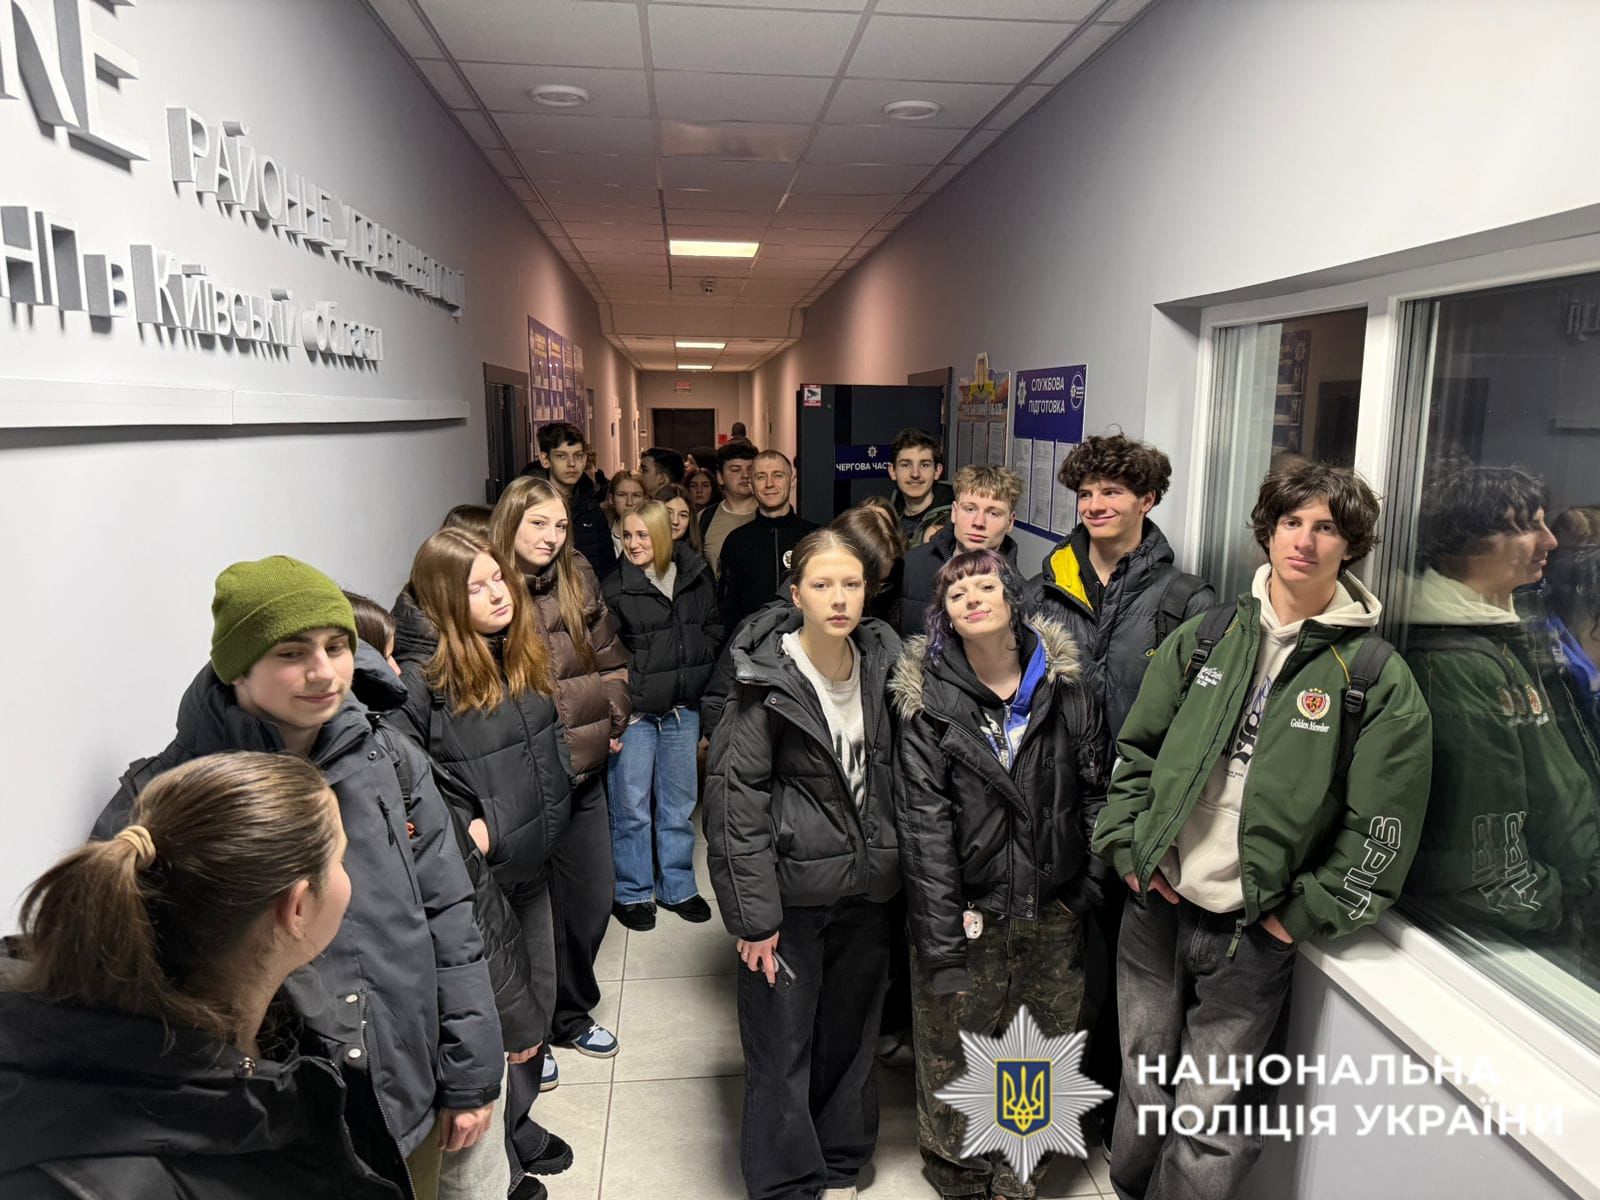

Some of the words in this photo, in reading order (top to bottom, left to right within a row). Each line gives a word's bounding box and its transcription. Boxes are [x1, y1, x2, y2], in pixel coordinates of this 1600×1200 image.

[1031, 376, 1065, 392] СЛУЖБОВА
[1028, 399, 1066, 415] ПІДГОТОВКА
[835, 462, 871, 471] ЧЕРГОВА
[1290, 718, 1309, 729] Golden
[1309, 721, 1330, 733] Member
